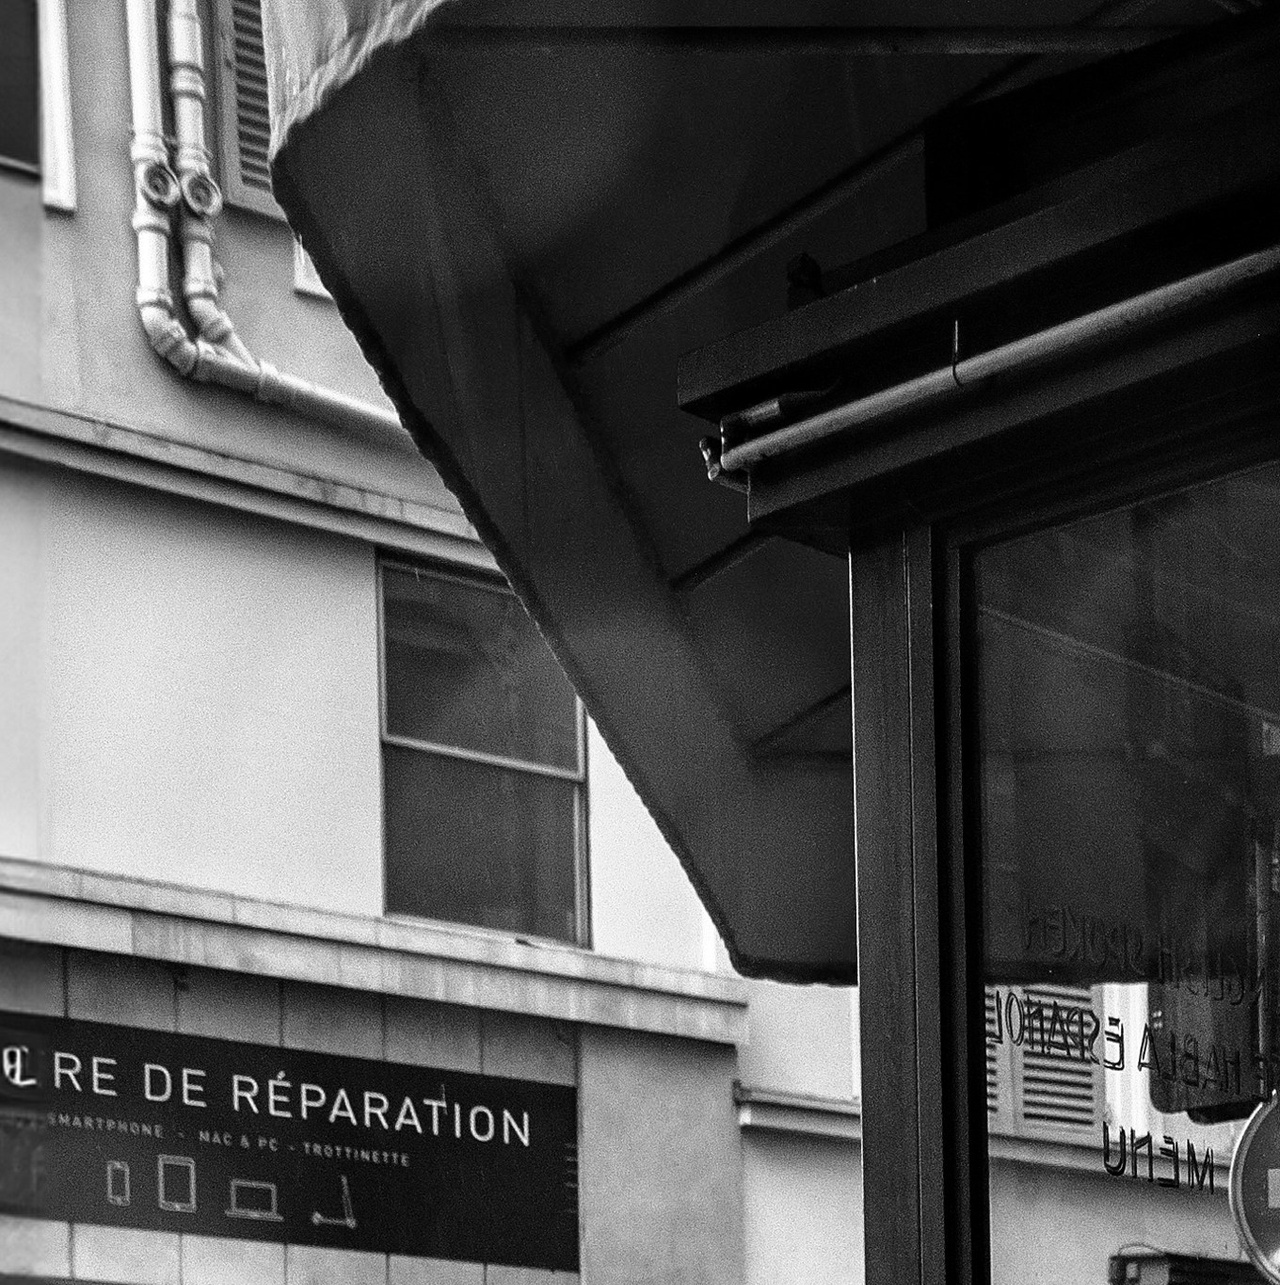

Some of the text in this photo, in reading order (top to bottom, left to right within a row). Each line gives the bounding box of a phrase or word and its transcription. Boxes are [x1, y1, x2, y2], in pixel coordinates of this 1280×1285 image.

[47, 1112, 163, 1139] SMARTPHONE
[303, 1141, 411, 1167] TROTTINETTE
[144, 1063, 206, 1108] DE
[232, 1071, 530, 1147] RÉPARATION
